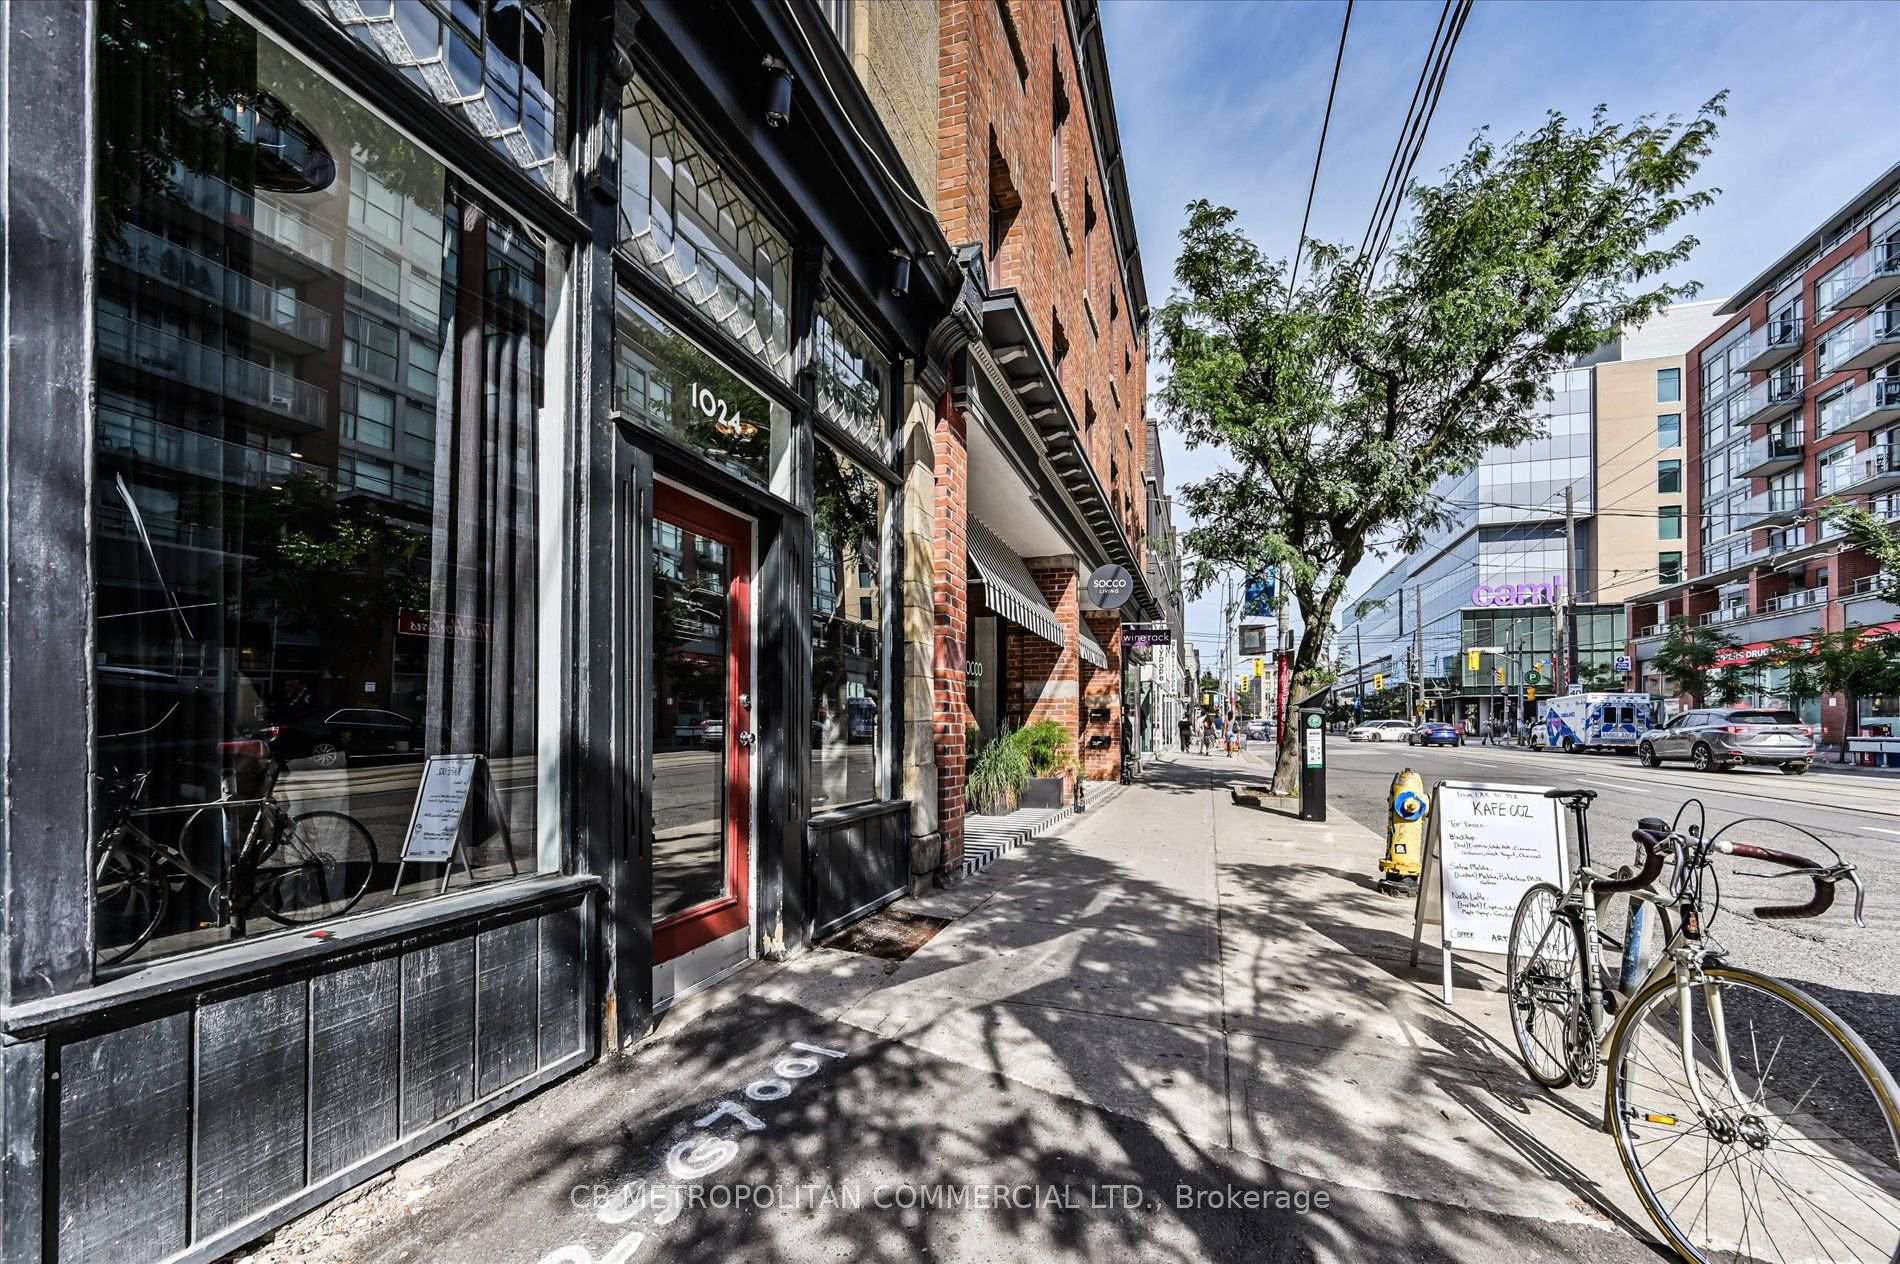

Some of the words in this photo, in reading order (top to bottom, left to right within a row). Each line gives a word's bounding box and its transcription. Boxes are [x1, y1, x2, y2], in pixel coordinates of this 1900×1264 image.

[692, 382, 742, 435] 1024
[1093, 579, 1127, 588] SOCCO
[966, 660, 983, 677] OCCO
[1472, 801, 1507, 816] KAFE
